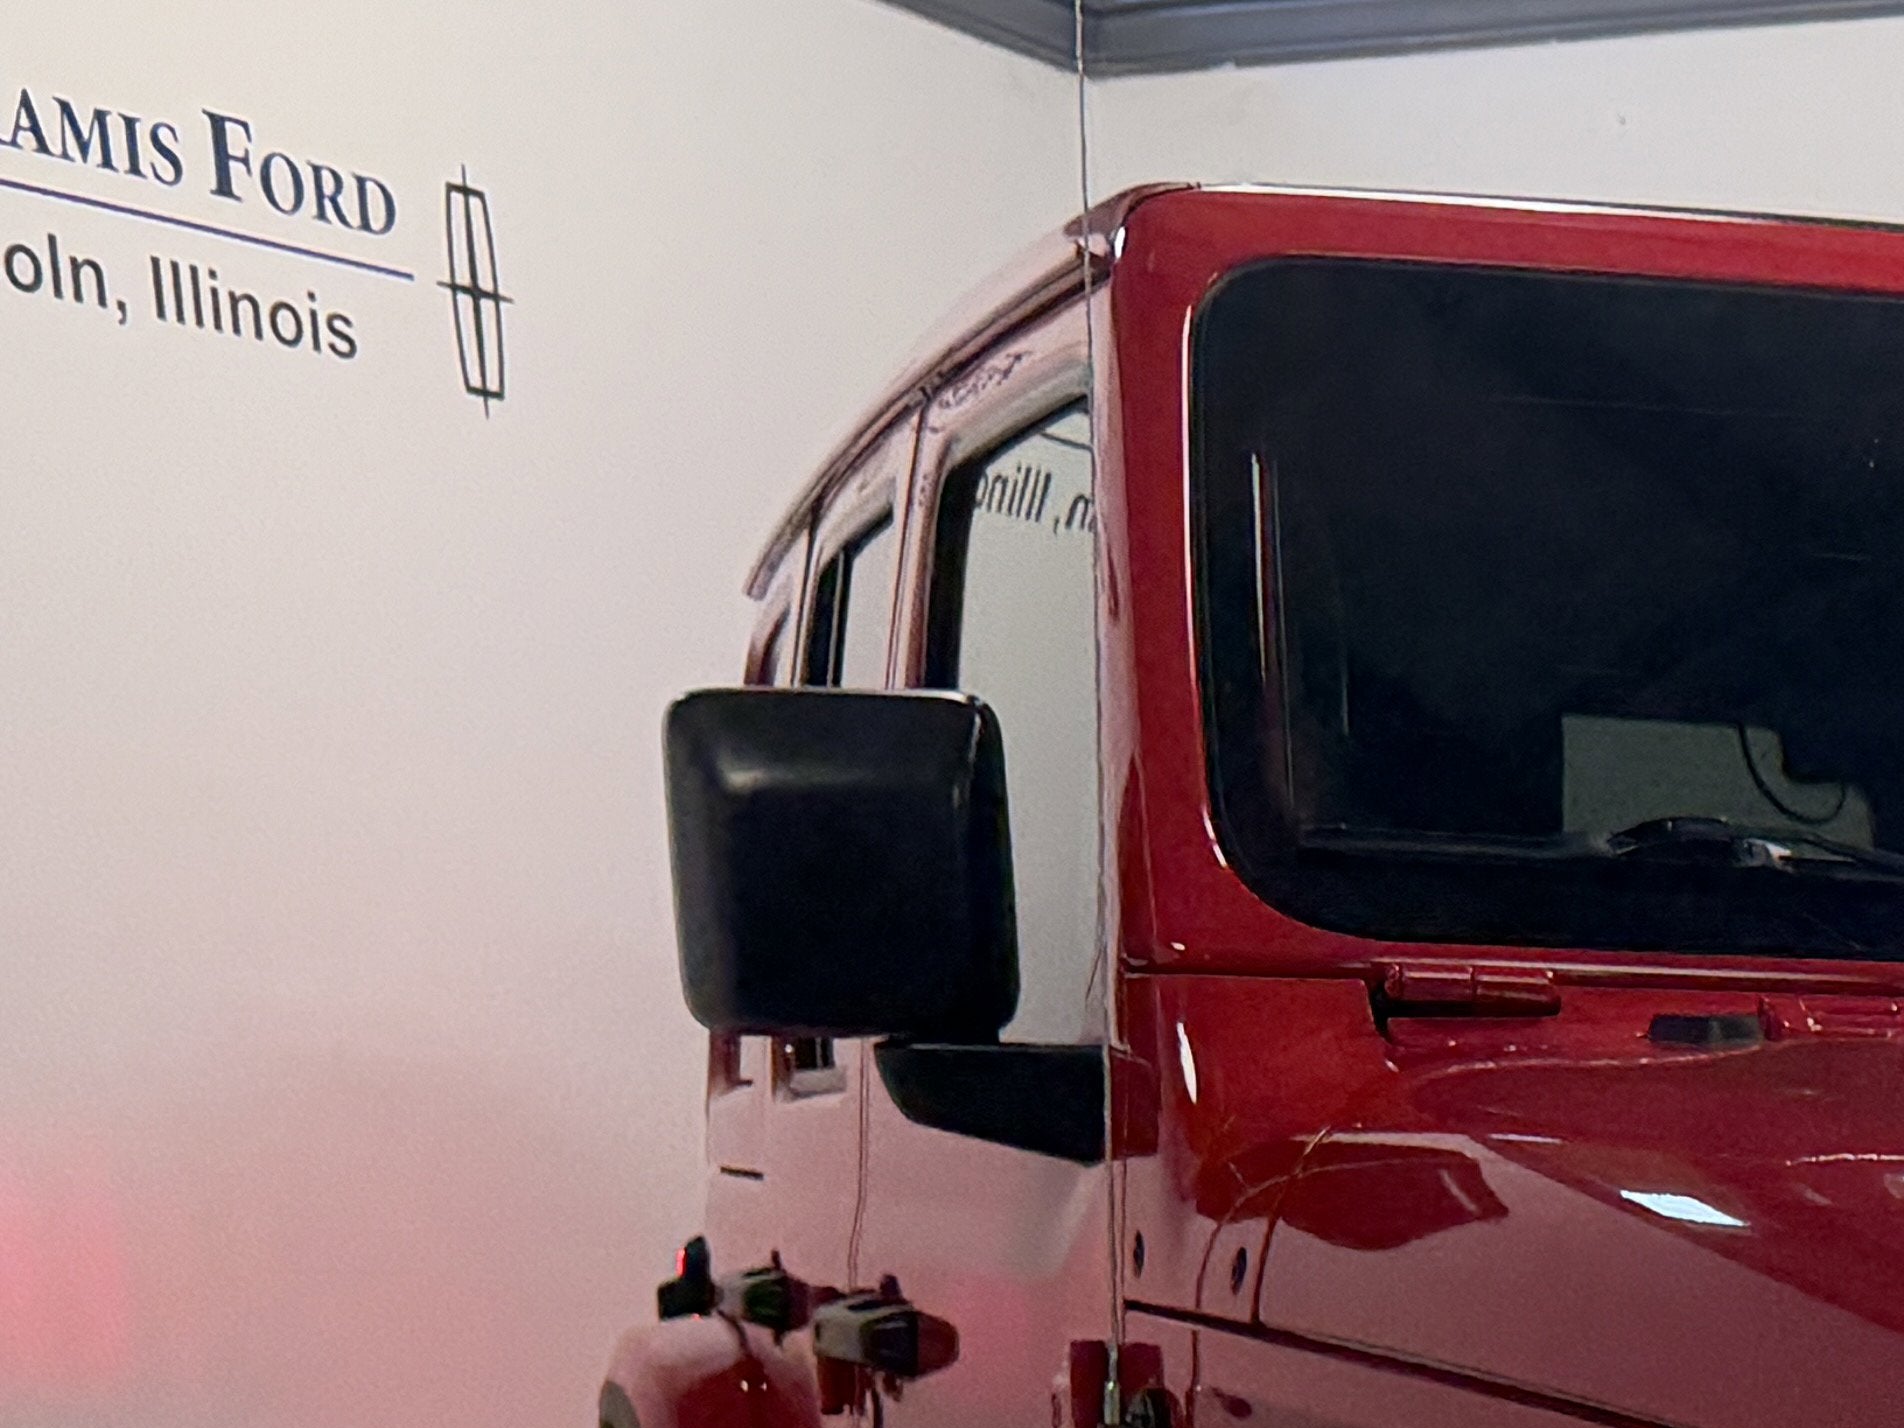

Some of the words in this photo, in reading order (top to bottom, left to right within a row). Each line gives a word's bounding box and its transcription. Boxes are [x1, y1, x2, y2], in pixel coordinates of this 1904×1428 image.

[0, 88, 184, 187] AMIS
[201, 108, 397, 237] FORD
[150, 255, 358, 361] Illinois
